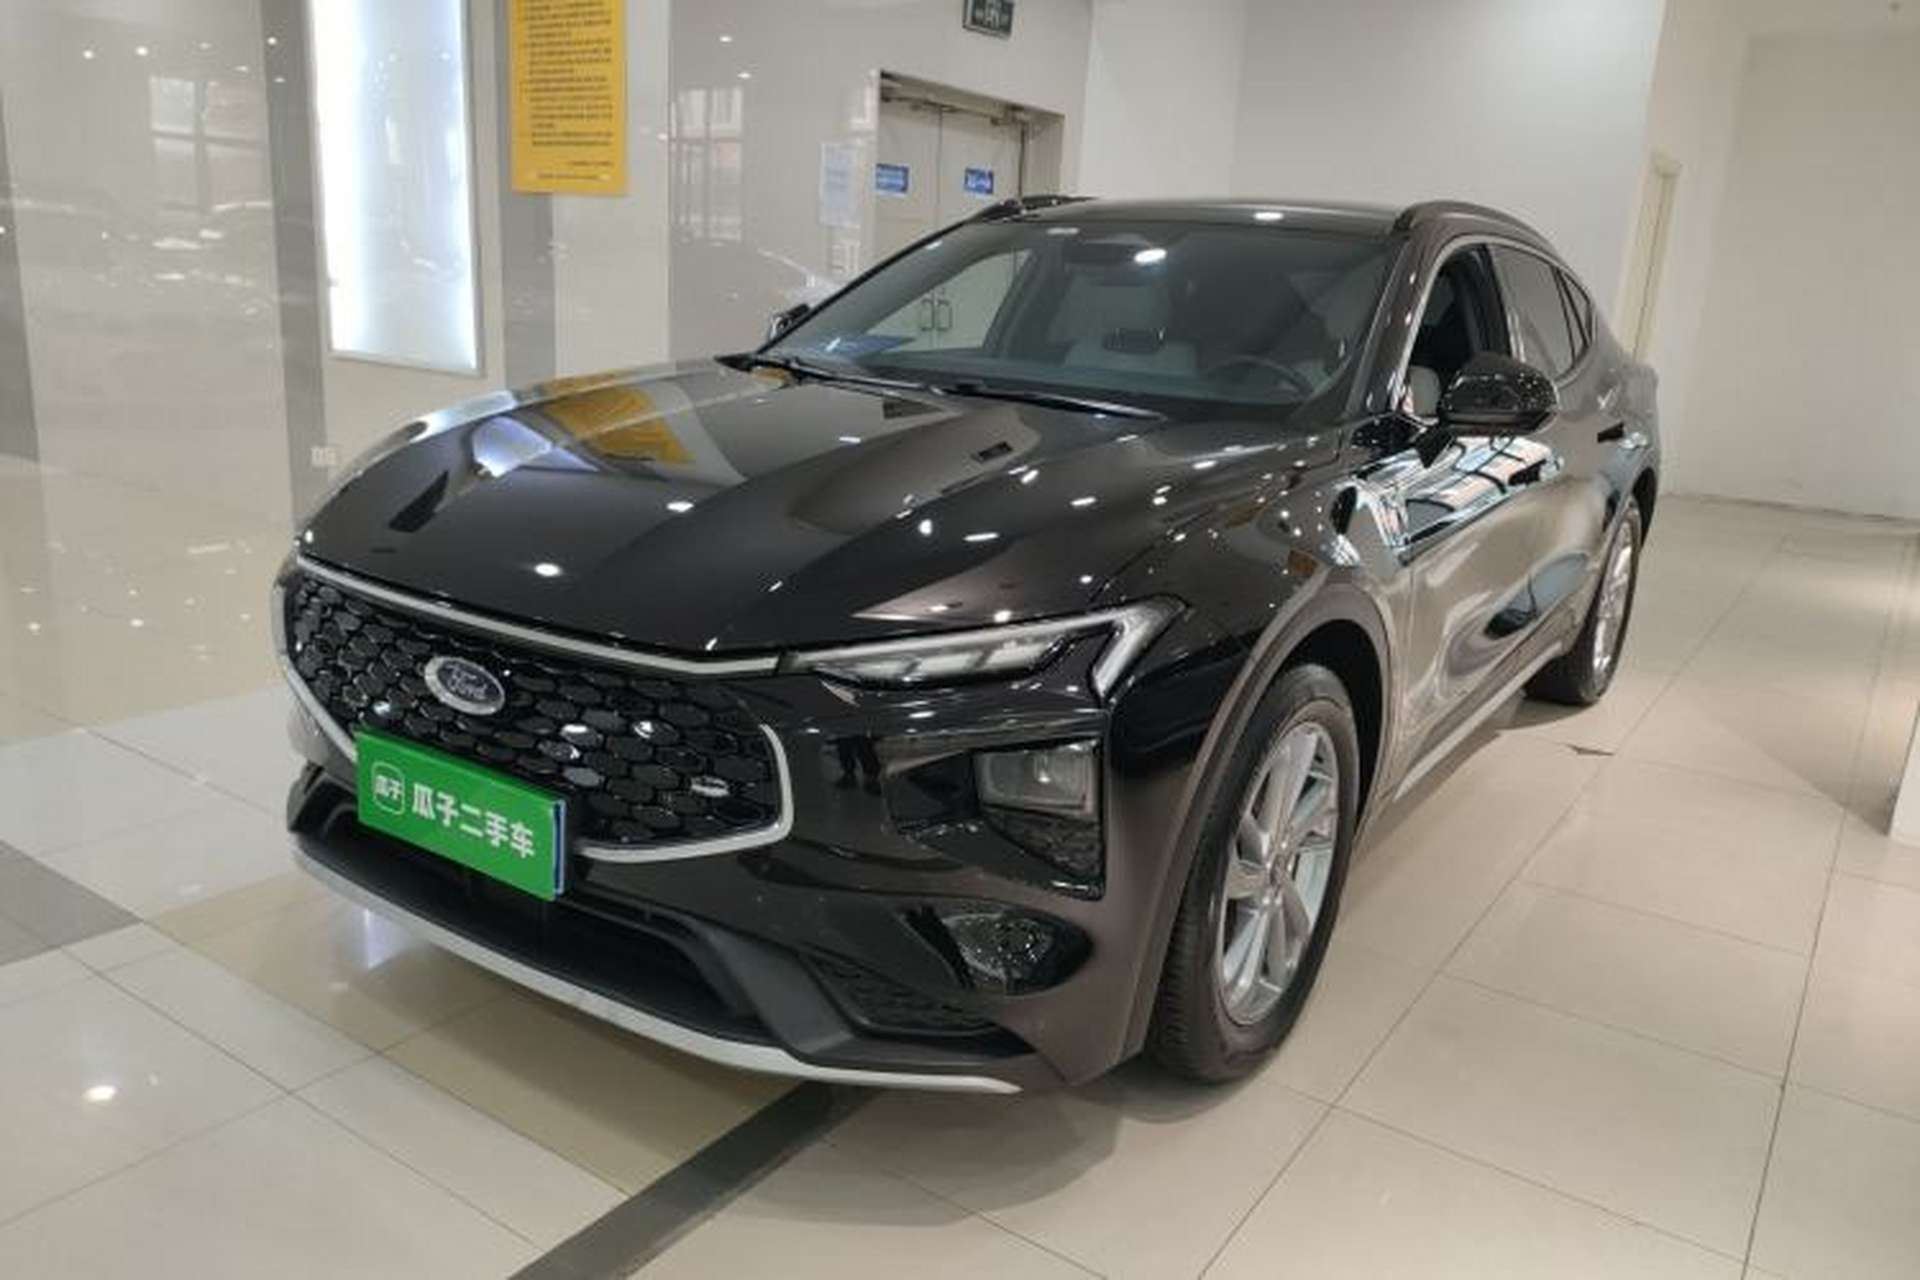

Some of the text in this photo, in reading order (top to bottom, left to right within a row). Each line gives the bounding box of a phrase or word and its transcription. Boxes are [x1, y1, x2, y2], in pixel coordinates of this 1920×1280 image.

[445, 664, 488, 700] Ford
[412, 782, 535, 859] 瓜子二手车
